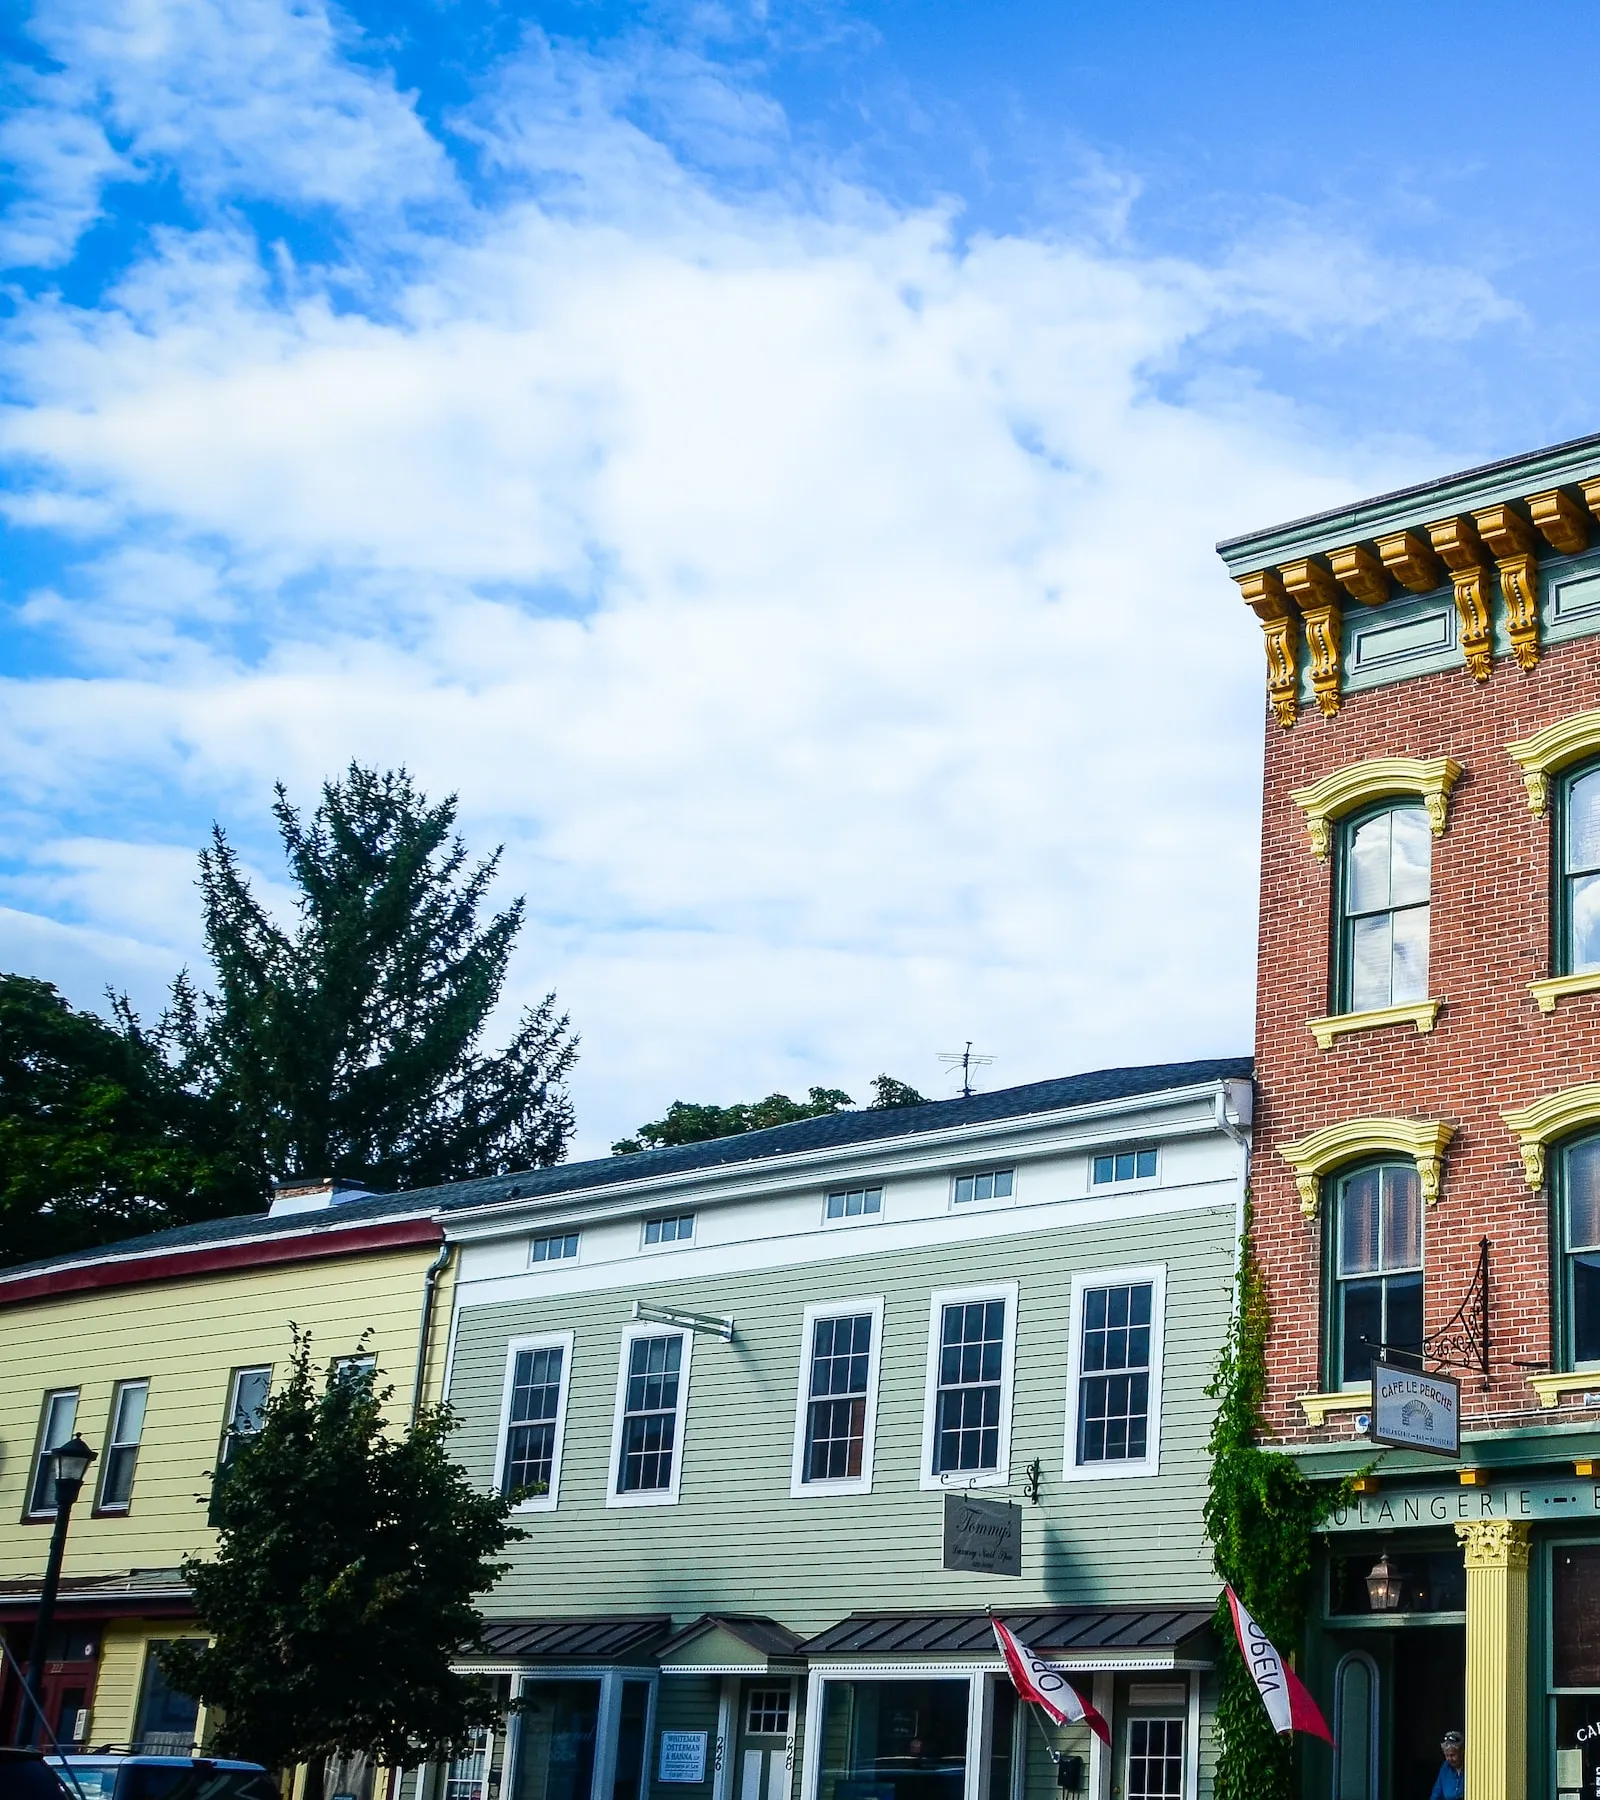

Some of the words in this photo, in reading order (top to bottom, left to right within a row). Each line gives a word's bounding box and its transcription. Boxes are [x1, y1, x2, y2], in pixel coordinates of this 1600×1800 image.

[1381, 1381, 1404, 1398] CAFE
[1406, 1381, 1417, 1394] LE
[1419, 1382, 1453, 1412] PERCHE
[1312, 1490, 1532, 1526] ULANGERIE
[956, 1505, 1012, 1548] Tommy's
[714, 1736, 724, 1771] 226
[785, 1736, 794, 1771] 228
